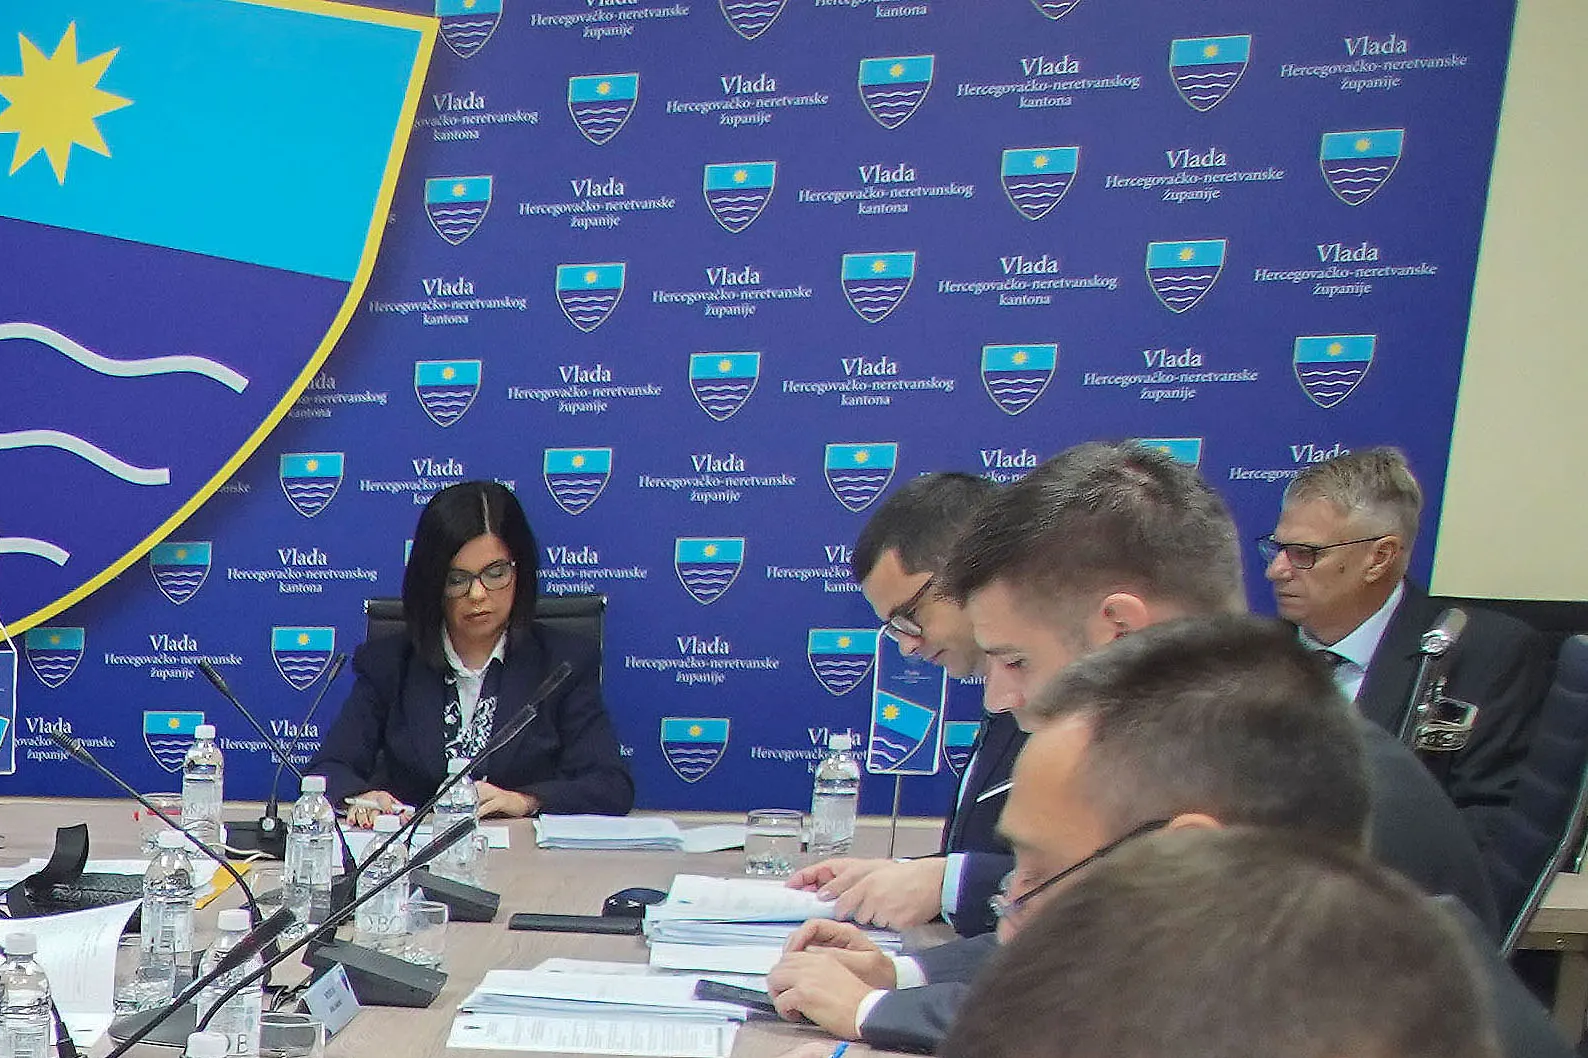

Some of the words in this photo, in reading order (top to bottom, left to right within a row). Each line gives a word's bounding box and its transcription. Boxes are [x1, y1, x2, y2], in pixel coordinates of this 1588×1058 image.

[529, 4, 690, 27] Hercegovačko-neretvanske
[876, 3, 930, 17] kantona
[583, 20, 637, 40] županije
[1345, 32, 1410, 56] Vlada
[1021, 55, 1081, 75] Vlada
[1281, 54, 1467, 78] Hercegovačko-neretvanske
[721, 72, 780, 96] Vlada
[957, 75, 1142, 97] Hercegovačko-neretvanskog
[1339, 73, 1402, 92] županije
[433, 91, 485, 110] Vlada
[667, 92, 829, 114] Hercegovačko-neretvanske
[1019, 93, 1075, 108] kantona
[719, 110, 773, 128] županije
[432, 127, 481, 141] kantona
[1166, 146, 1230, 168] Vlada
[859, 163, 919, 183] Vlada
[1105, 167, 1284, 190] Hercegovačko-neretvanske
[571, 176, 627, 198] Vlada
[799, 182, 976, 204] Hercegovačko-neretvanskog
[1161, 184, 1222, 203] županije
[519, 195, 676, 217] Hercegovačko-neretvanske
[858, 200, 911, 215] kantona
[571, 213, 621, 230] županije
[1317, 240, 1382, 262] Vlada
[1000, 254, 1061, 276] Vlada
[1254, 263, 1438, 283] Hercegovačko-neretvanske
[706, 265, 763, 285] Vlada
[939, 274, 1120, 294] Hercegovačko-neretvanskog
[419, 276, 476, 296] Vlada
[653, 285, 812, 305] Hercegovačko-neretvanske
[1313, 282, 1372, 297] županije
[370, 296, 528, 315] Hercegovačko-neretvanskog
[1000, 292, 1052, 305] kantona
[421, 312, 468, 325] kantona
[705, 301, 757, 318] županije
[841, 356, 901, 376] Vlada
[1144, 347, 1205, 367] Vlada
[556, 363, 616, 385] Vlada
[1083, 368, 1259, 387] Hercegovačko-neretvanske
[508, 383, 663, 401] Hercegovačko-neretvanske
[781, 376, 956, 398] Hercegovačko-neretvanskog
[1140, 385, 1197, 402] županije
[559, 399, 608, 415] županije
[838, 393, 893, 406] kantona
[413, 458, 465, 476] Vlada
[689, 452, 747, 473] Vlada
[981, 448, 1038, 468] Vlada
[639, 473, 796, 490] Hercegovačko-neretvanske
[691, 488, 742, 504] županije
[278, 548, 327, 566] Vlada
[547, 545, 600, 564] Vlada
[227, 567, 378, 583] Hercegovačko-neretvanskog
[278, 581, 323, 593] kantona
[545, 580, 595, 596] županije
[149, 634, 198, 652] Vlada
[676, 635, 732, 654] Vlada
[625, 655, 782, 672] Hercegovačko-neretvanske
[150, 667, 195, 680] županije
[676, 669, 729, 685] županije
